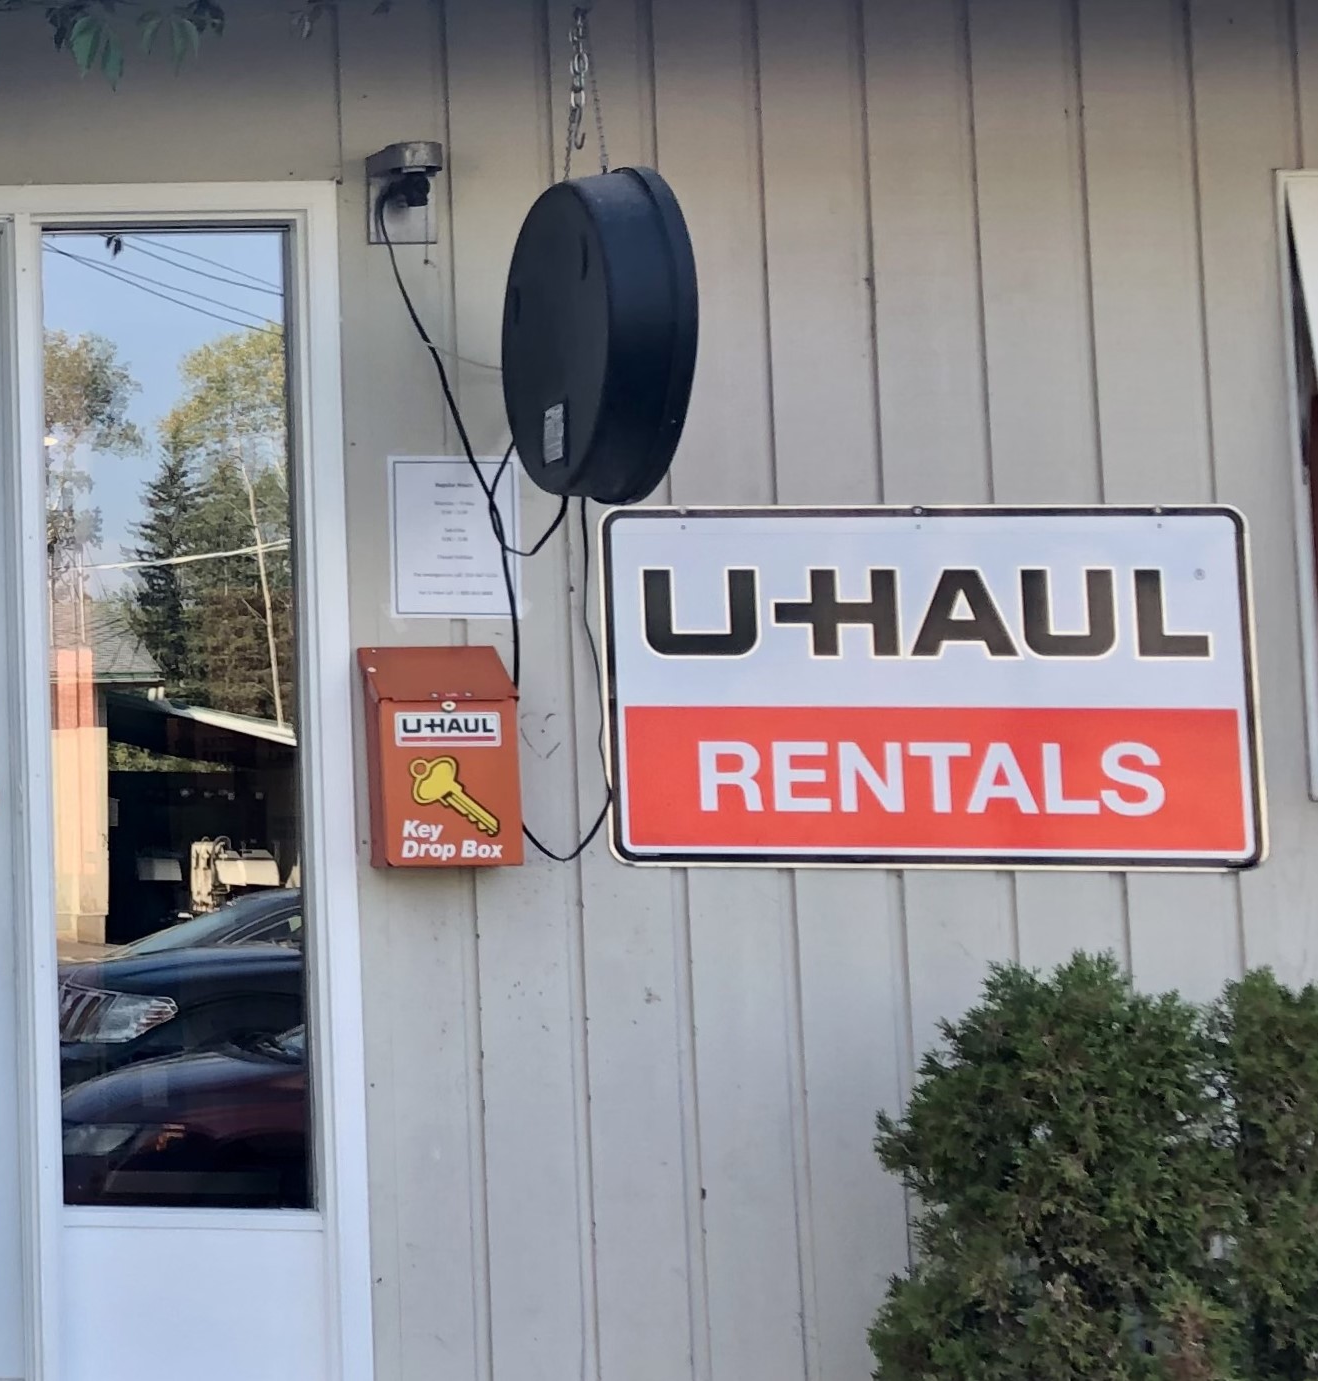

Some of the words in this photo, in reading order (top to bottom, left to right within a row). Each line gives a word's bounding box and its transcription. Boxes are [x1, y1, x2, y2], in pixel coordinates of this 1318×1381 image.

[641, 568, 1210, 656] U-HAUL
[402, 718, 495, 734] U-HAUL
[698, 740, 1166, 816] RENTALS
[402, 820, 443, 841] Key
[401, 841, 456, 861] Drop
[461, 840, 503, 858] Box
